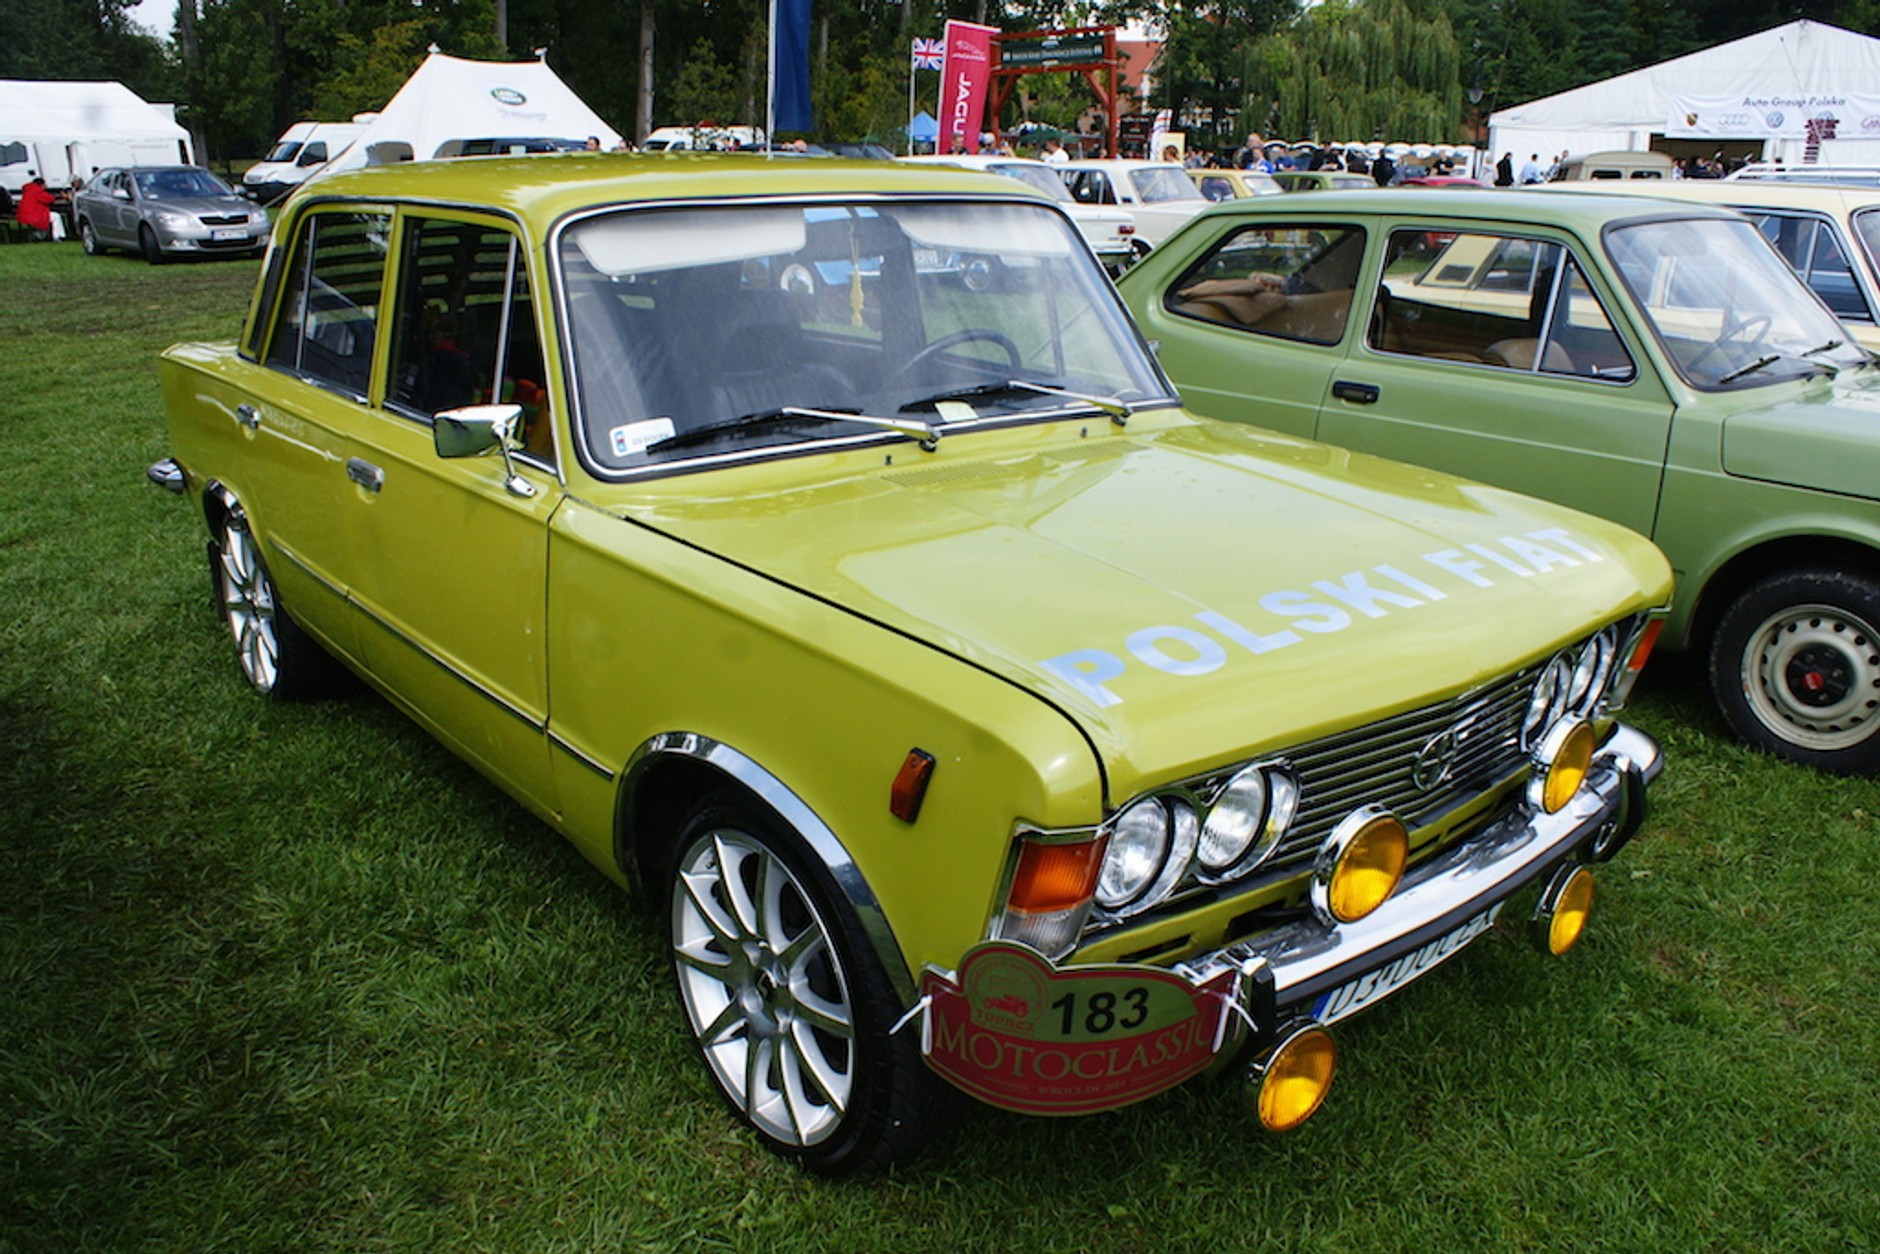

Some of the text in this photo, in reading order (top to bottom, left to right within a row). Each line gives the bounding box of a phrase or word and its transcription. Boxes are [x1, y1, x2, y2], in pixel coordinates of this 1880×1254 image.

[1742, 97, 1769, 107] Auto
[1771, 96, 1806, 108] Group
[1036, 527, 1604, 708] POLSKI FIAT
[1052, 987, 1150, 1036] 183
[934, 1009, 1211, 1081] MOTOCLASSIC
